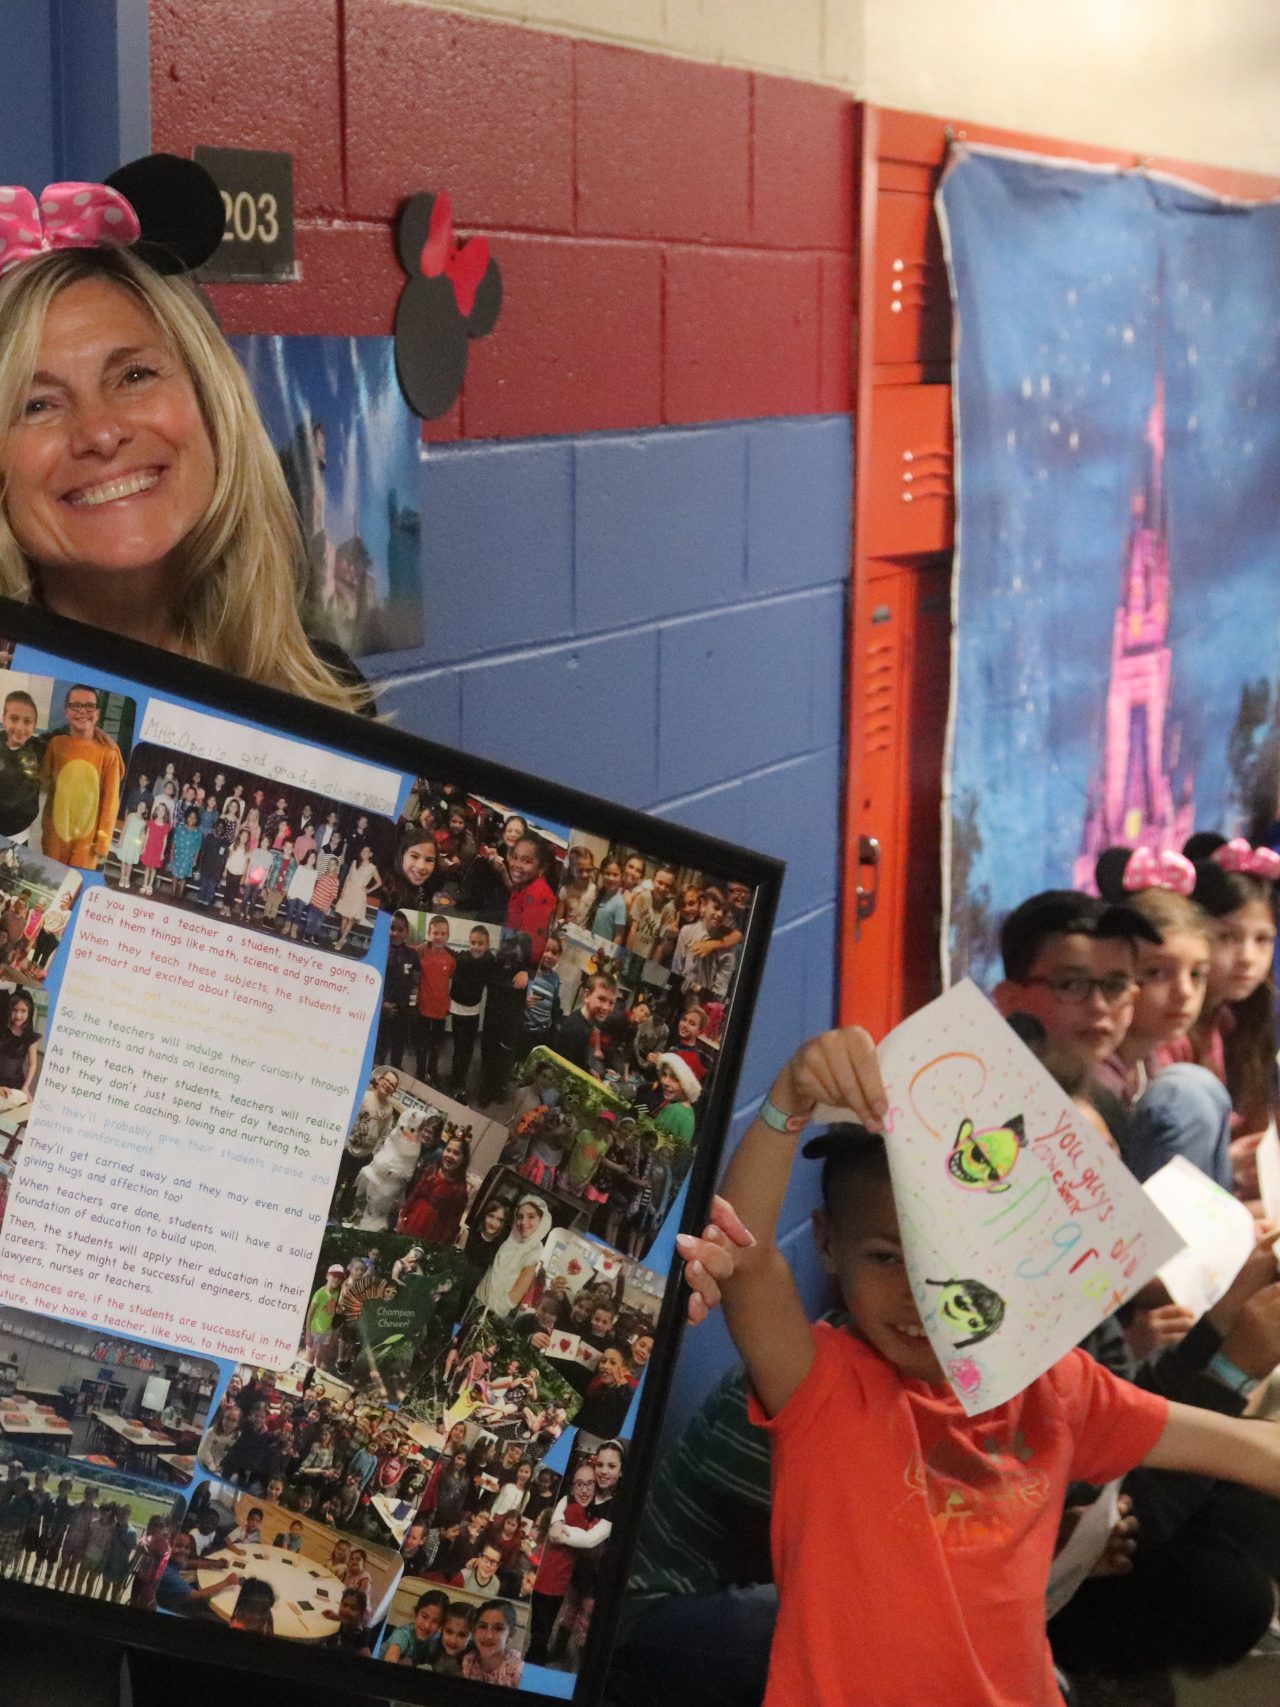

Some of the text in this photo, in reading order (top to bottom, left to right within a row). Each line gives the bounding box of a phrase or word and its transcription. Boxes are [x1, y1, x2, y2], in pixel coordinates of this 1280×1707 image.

[79, 929, 366, 1022] When they teach these subjects, the students will
[85, 908, 350, 995] teach them things like math, science and grammar.
[88, 891, 375, 985] If you give a teacher a student, they're going to
[74, 948, 275, 1014] get smart and excited about learning.
[48, 1060, 338, 1147] that they don't just spend their day teaching, but
[50, 1044, 342, 1132] As they teach their students, teachers will realize
[19, 1175, 313, 1260] When teachers are done, students will have a solid
[23, 1155, 183, 1203] giving hugs and affection too!
[29, 1136, 321, 1224] They'll get carried away and they may even end up
[9, 1213, 305, 1296] Then, the students will apply their education in their
[14, 1191, 216, 1252] foundation of education to build upon.
[0, 1247, 153, 1294] lawyers, nurses or teachers.
[4, 1232, 299, 1314] careers. They might be successful engineers, doctors,
[19, 1277, 62, 1295] chances
[66, 1289, 88, 1302] are,
[92, 1293, 103, 1304] if
[107, 1296, 125, 1310] the
[128, 1303, 174, 1322] students
[178, 1316, 198, 1328] are
[201, 1321, 256, 1342] successful
[259, 1336, 269, 1345] in
[274, 1337, 292, 1351] the
[34, 1296, 58, 1312] they
[61, 1303, 88, 1318] have
[91, 1313, 99, 1321] a
[103, 1313, 146, 1333] teacher,
[151, 1325, 171, 1338] like
[174, 1332, 195, 1345] you,
[201, 1336, 212, 1348] to
[216, 1340, 245, 1356] thank
[251, 1348, 267, 1361] for
[269, 1354, 281, 1365] it.
[377, 1306, 416, 1319] Champion
